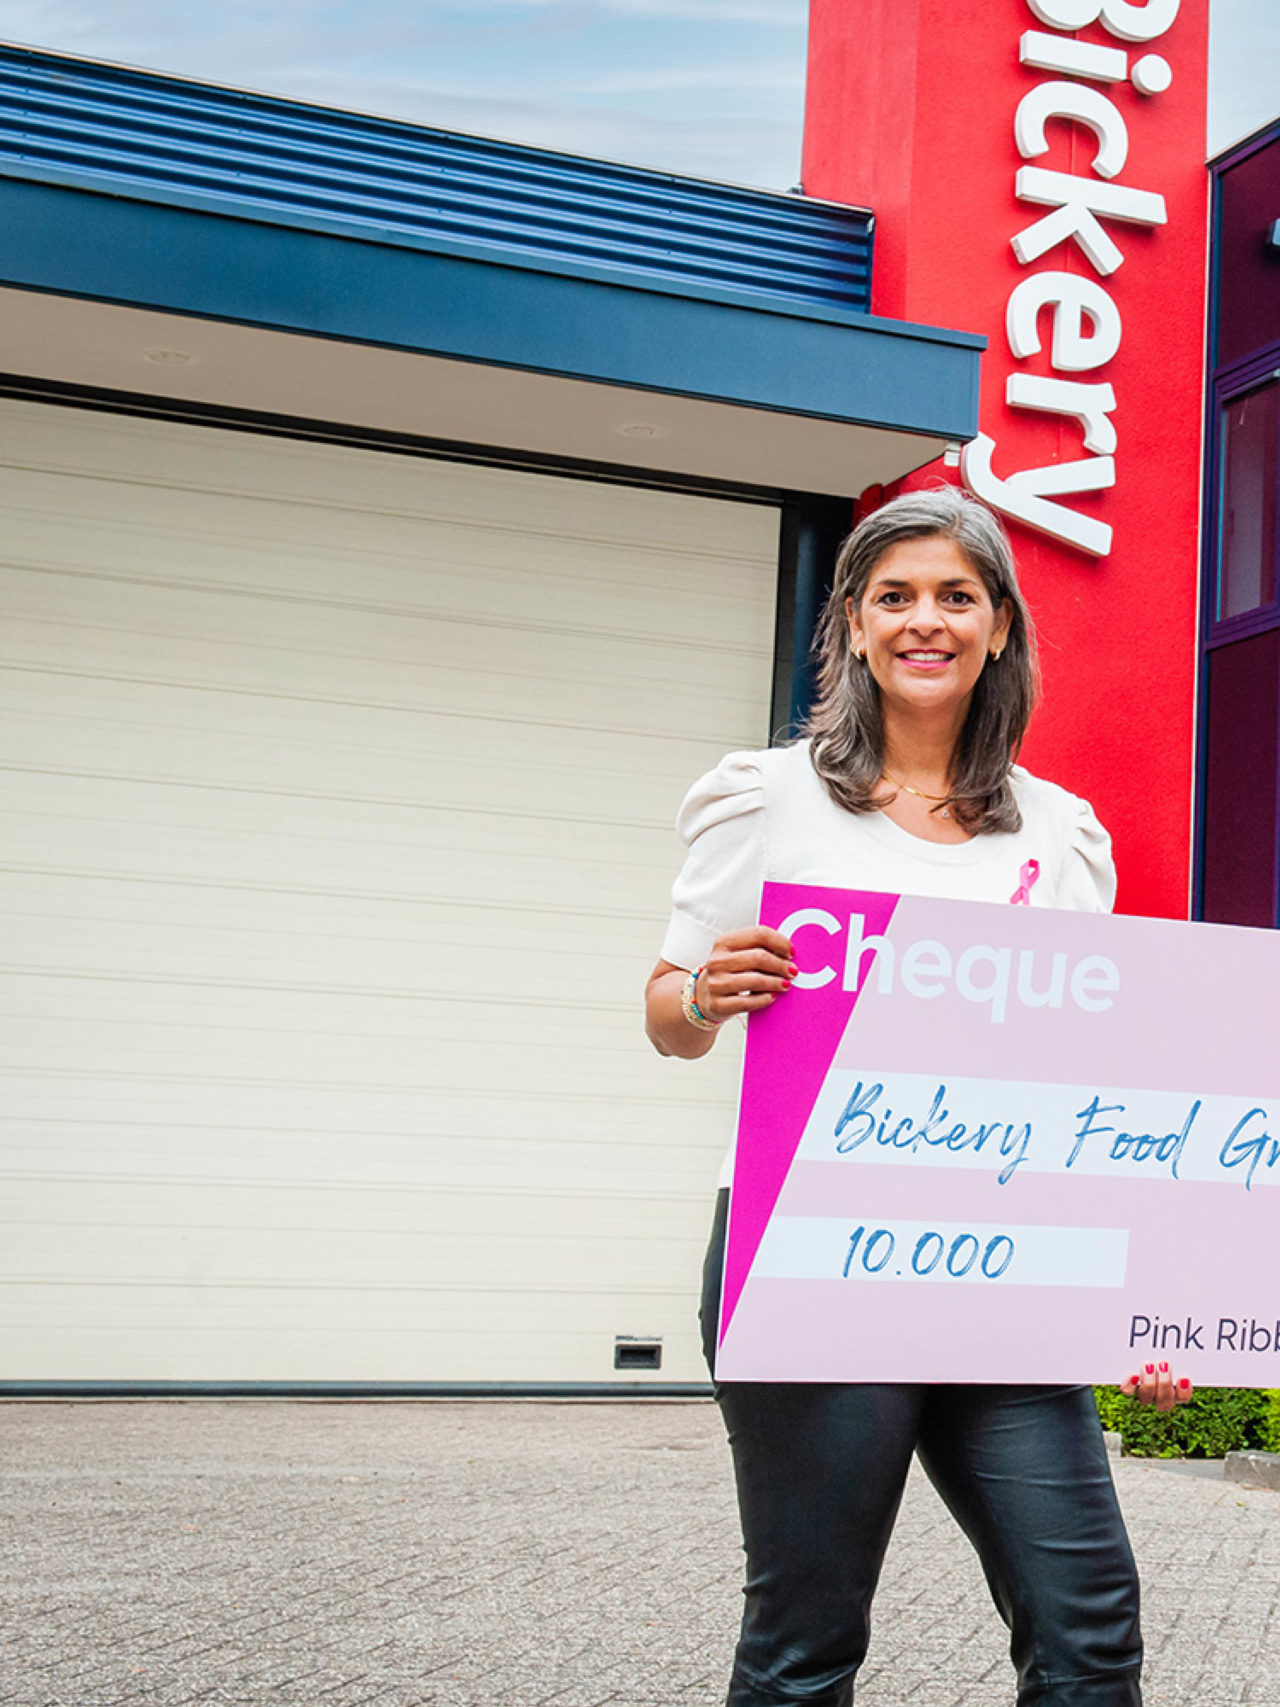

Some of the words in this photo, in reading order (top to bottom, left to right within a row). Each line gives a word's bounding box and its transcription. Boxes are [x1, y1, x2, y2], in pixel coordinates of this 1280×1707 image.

[777, 908, 1120, 1023] Cheque
[834, 1081, 1031, 1185] Bickery
[1066, 1095, 1202, 1180] Food
[843, 1225, 1015, 1280] 10.000
[1129, 1315, 1204, 1350] Pink
